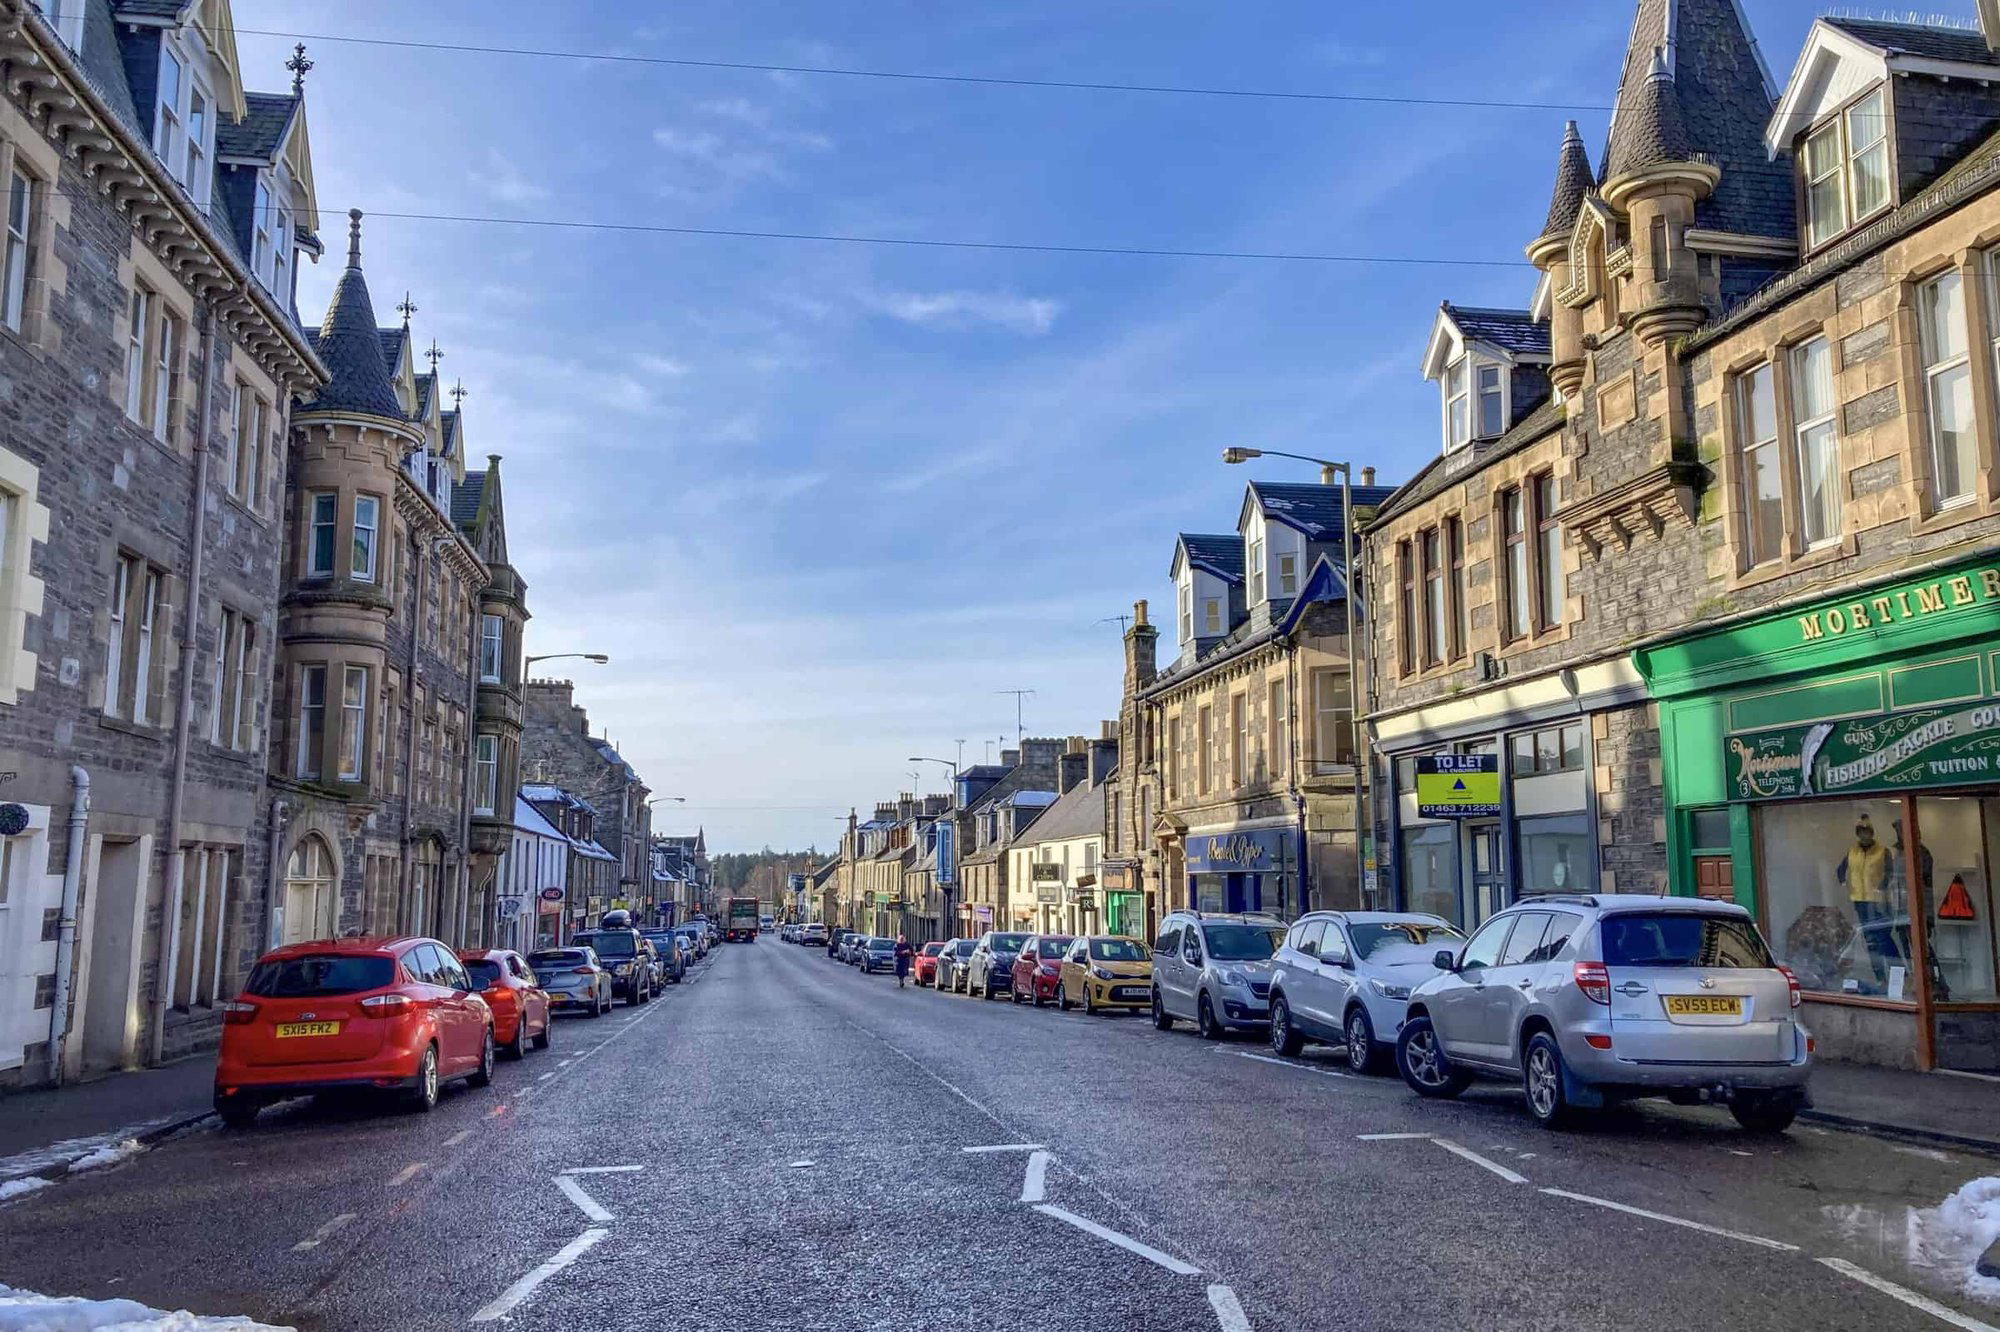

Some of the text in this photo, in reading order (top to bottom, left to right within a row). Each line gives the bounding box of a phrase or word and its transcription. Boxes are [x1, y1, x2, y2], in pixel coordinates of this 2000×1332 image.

[1799, 569, 2000, 640] MORTIMER
[1844, 731, 1875, 744] GUNS
[1826, 752, 1887, 785] FISHING
[1891, 719, 1954, 760] TACKLE
[1434, 756, 1484, 768] TO LET
[1929, 757, 1988, 774] TUITION
[1674, 999, 1736, 1012] SV59 ECW
[283, 1024, 307, 1036] SX15
